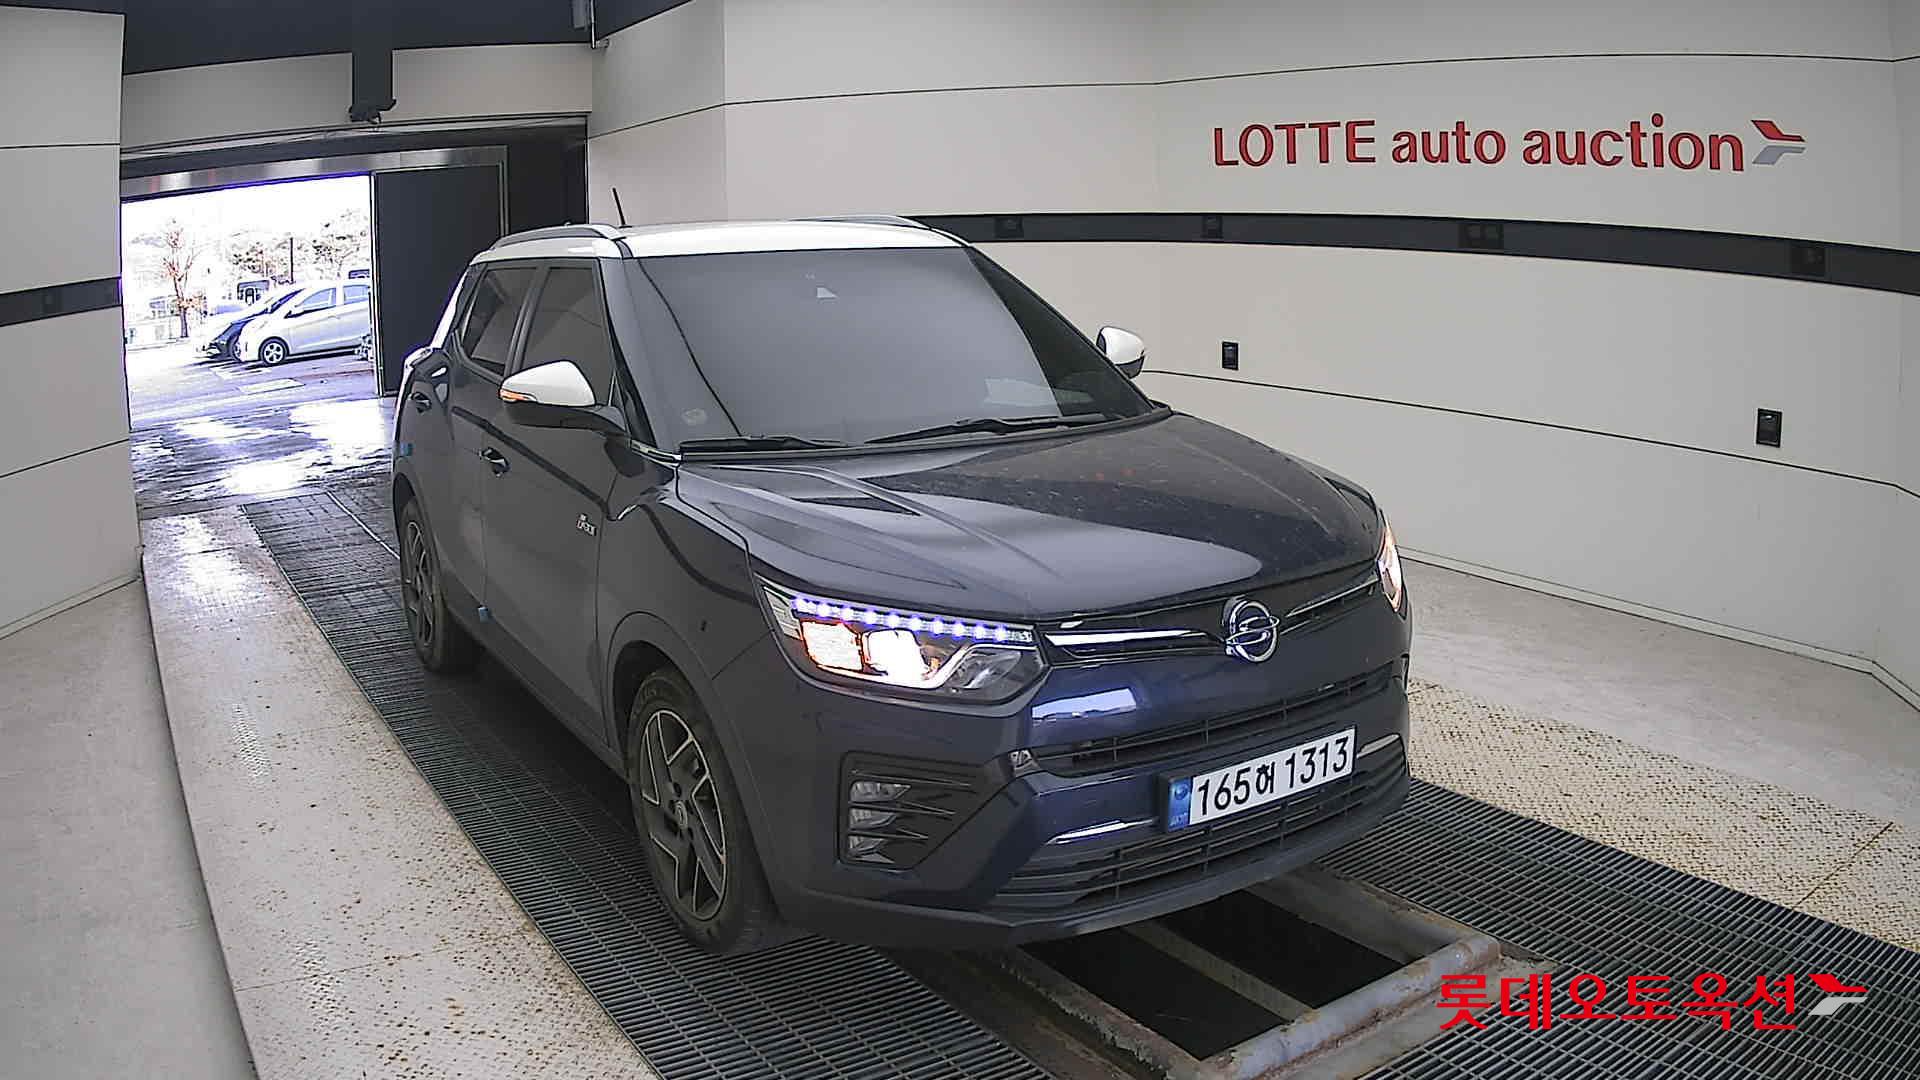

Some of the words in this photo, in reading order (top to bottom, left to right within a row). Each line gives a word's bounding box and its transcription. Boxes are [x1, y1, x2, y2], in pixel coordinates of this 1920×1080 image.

[1214, 120, 1375, 167] LOTTE
[1392, 121, 1507, 164] auto
[1523, 114, 1744, 171] auction
[1198, 762, 1276, 816] 165허
[1285, 736, 1350, 789] 1313
